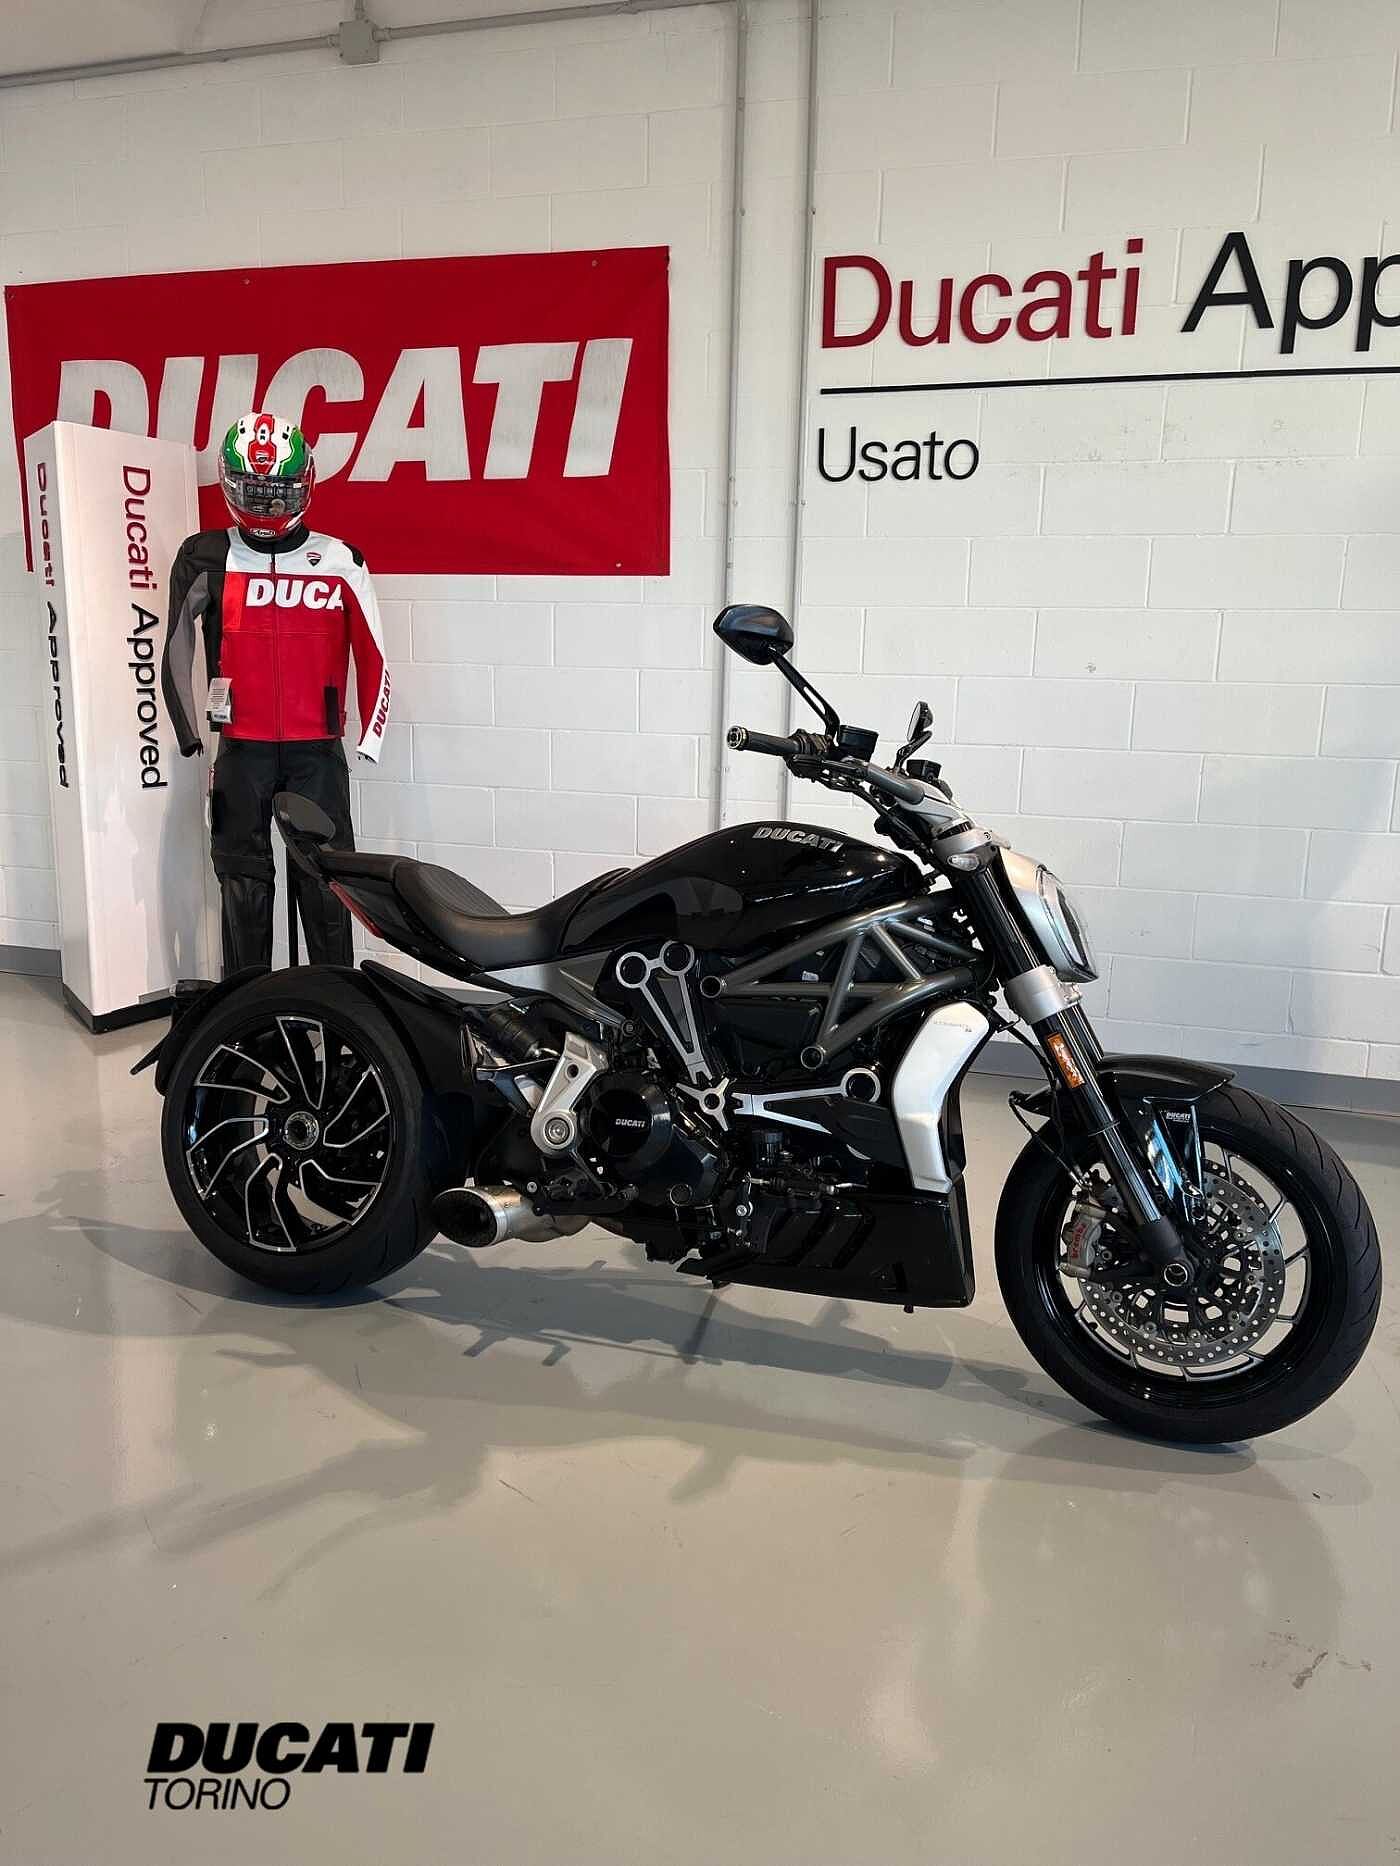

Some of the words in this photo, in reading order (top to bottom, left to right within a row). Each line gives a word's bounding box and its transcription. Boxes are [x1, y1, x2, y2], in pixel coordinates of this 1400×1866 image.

[821, 238, 1143, 348] Ducati
[1180, 231, 1400, 354] App
[817, 426, 980, 483] Usato
[122, 465, 158, 590] Ducati
[126, 603, 168, 789] Approved
[373, 669, 391, 738] DUCATI
[752, 827, 844, 853] DUCATI
[615, 1118, 646, 1128] DUCATI
